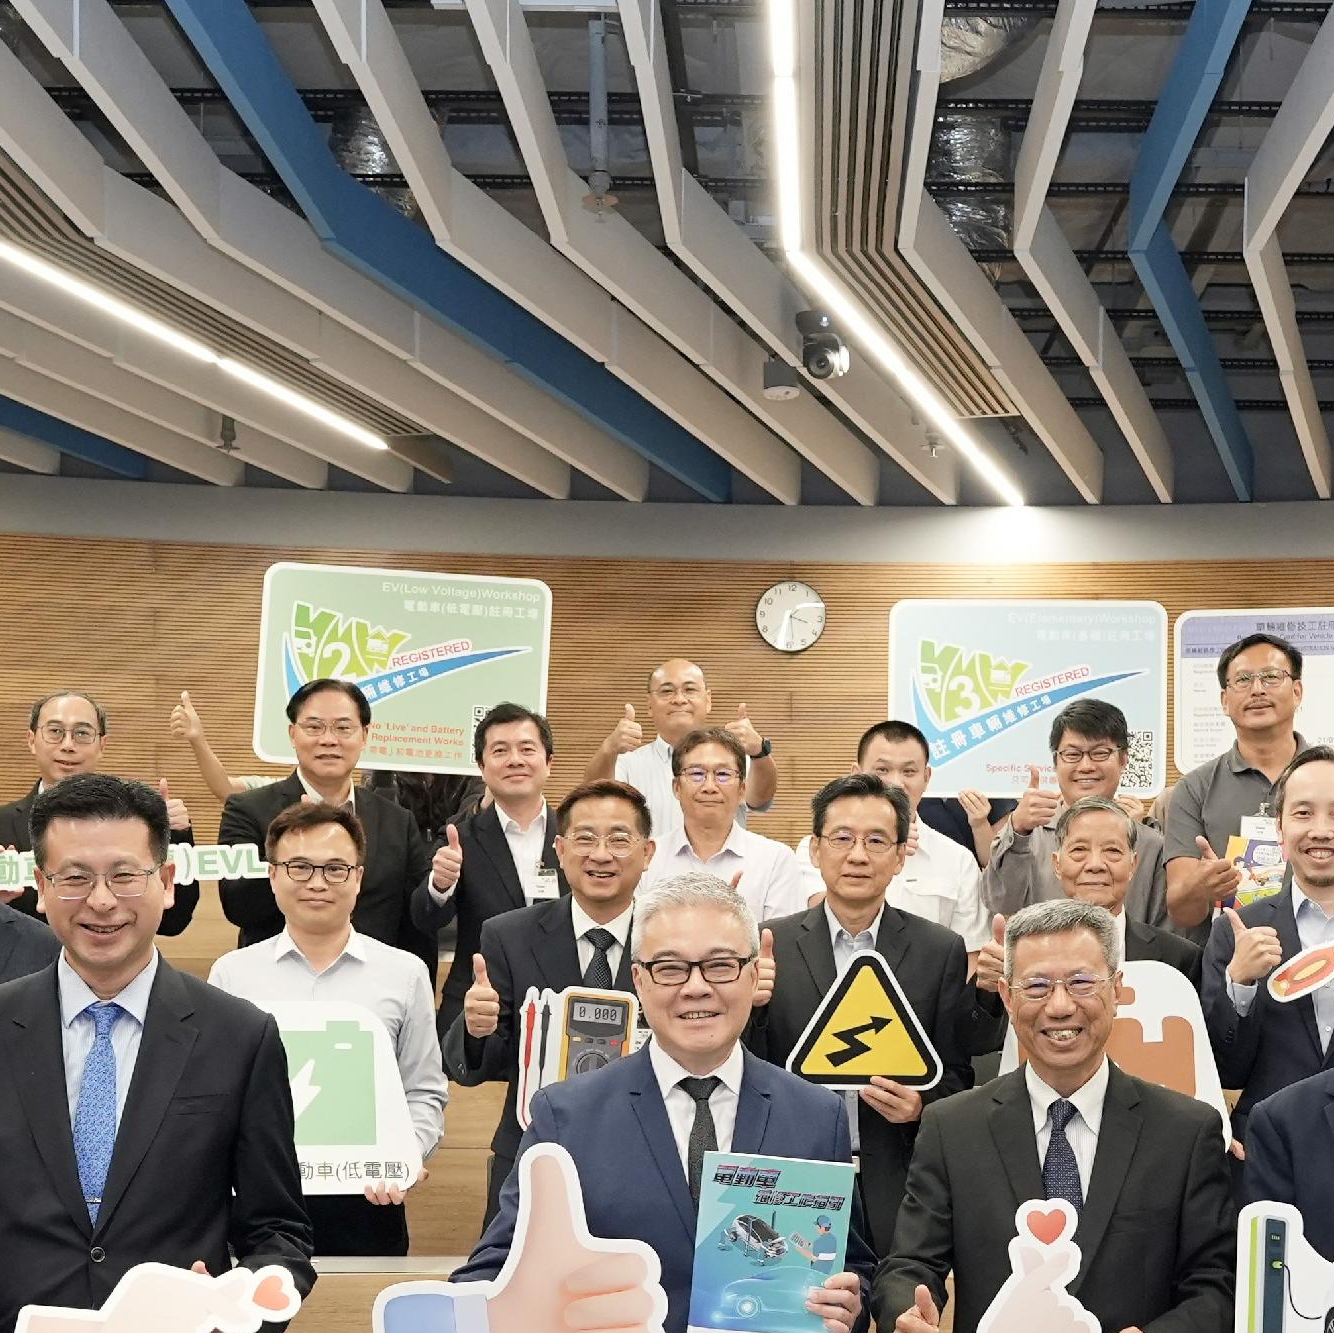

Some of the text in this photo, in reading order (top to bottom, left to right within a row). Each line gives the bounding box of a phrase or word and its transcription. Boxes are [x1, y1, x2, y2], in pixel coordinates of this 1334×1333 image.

[382, 582, 541, 604] EV(Low Voltage)Workshop
[392, 641, 471, 667] REGISTERED
[1014, 667, 1090, 697] REGISTERED
[371, 733, 464, 746] Replacement Works
[431, 725, 465, 736] Battery
[929, 695, 1052, 761] 註冊車輛維修工場
